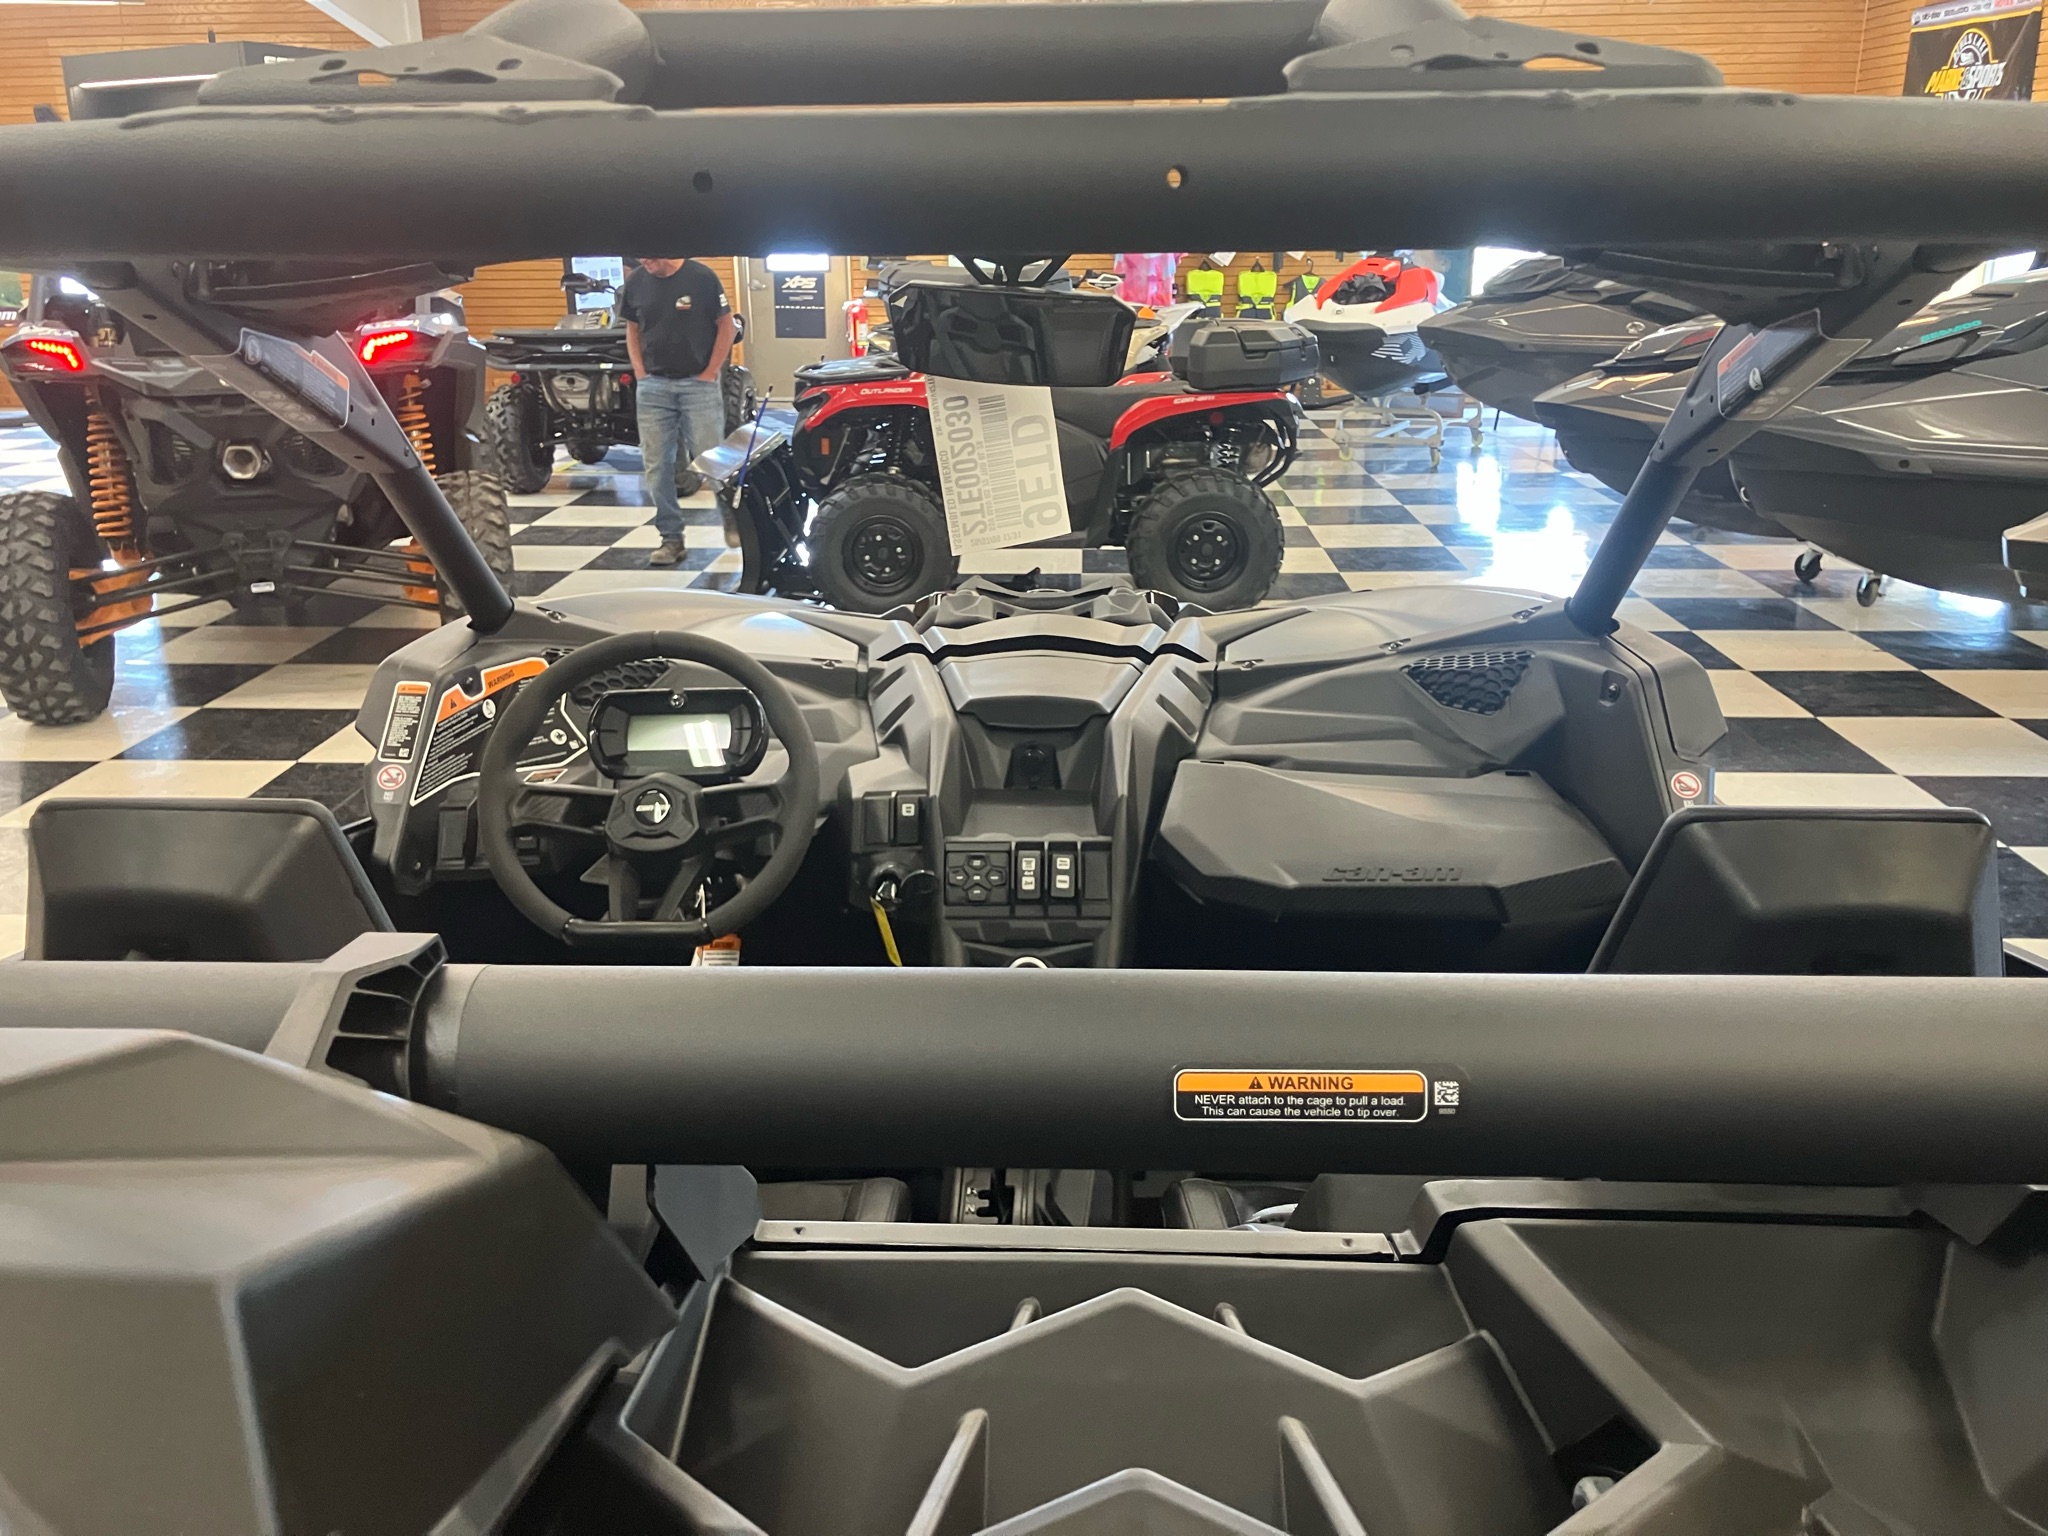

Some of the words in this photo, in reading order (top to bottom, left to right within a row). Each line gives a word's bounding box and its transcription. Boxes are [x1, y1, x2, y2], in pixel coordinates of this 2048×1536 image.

[782, 275, 818, 288] XPS
[488, 670, 514, 688] WARNING
[1322, 866, 1462, 882] can-am
[1269, 1076, 1354, 1090] WARNING
[1195, 1096, 1235, 1104] NEVER
[1239, 1096, 1270, 1104] attach
[1274, 1096, 1284, 1104] to
[1287, 1096, 1304, 1104] the
[1306, 1096, 1333, 1107] cage
[1336, 1096, 1346, 1104] to
[1349, 1096, 1368, 1107] pull
[1371, 1096, 1378, 1104] a
[1381, 1096, 1406, 1105] load.
[1202, 1106, 1224, 1116] This
[1227, 1106, 1246, 1116] can
[1249, 1106, 1282, 1116] cause
[1284, 1106, 1300, 1116] the
[1304, 1106, 1341, 1116] vehicle
[1344, 1106, 1354, 1116] to
[1357, 1106, 1370, 1119] tip
[1373, 1106, 1400, 1117] over.
[965, 1204, 976, 1213] N
